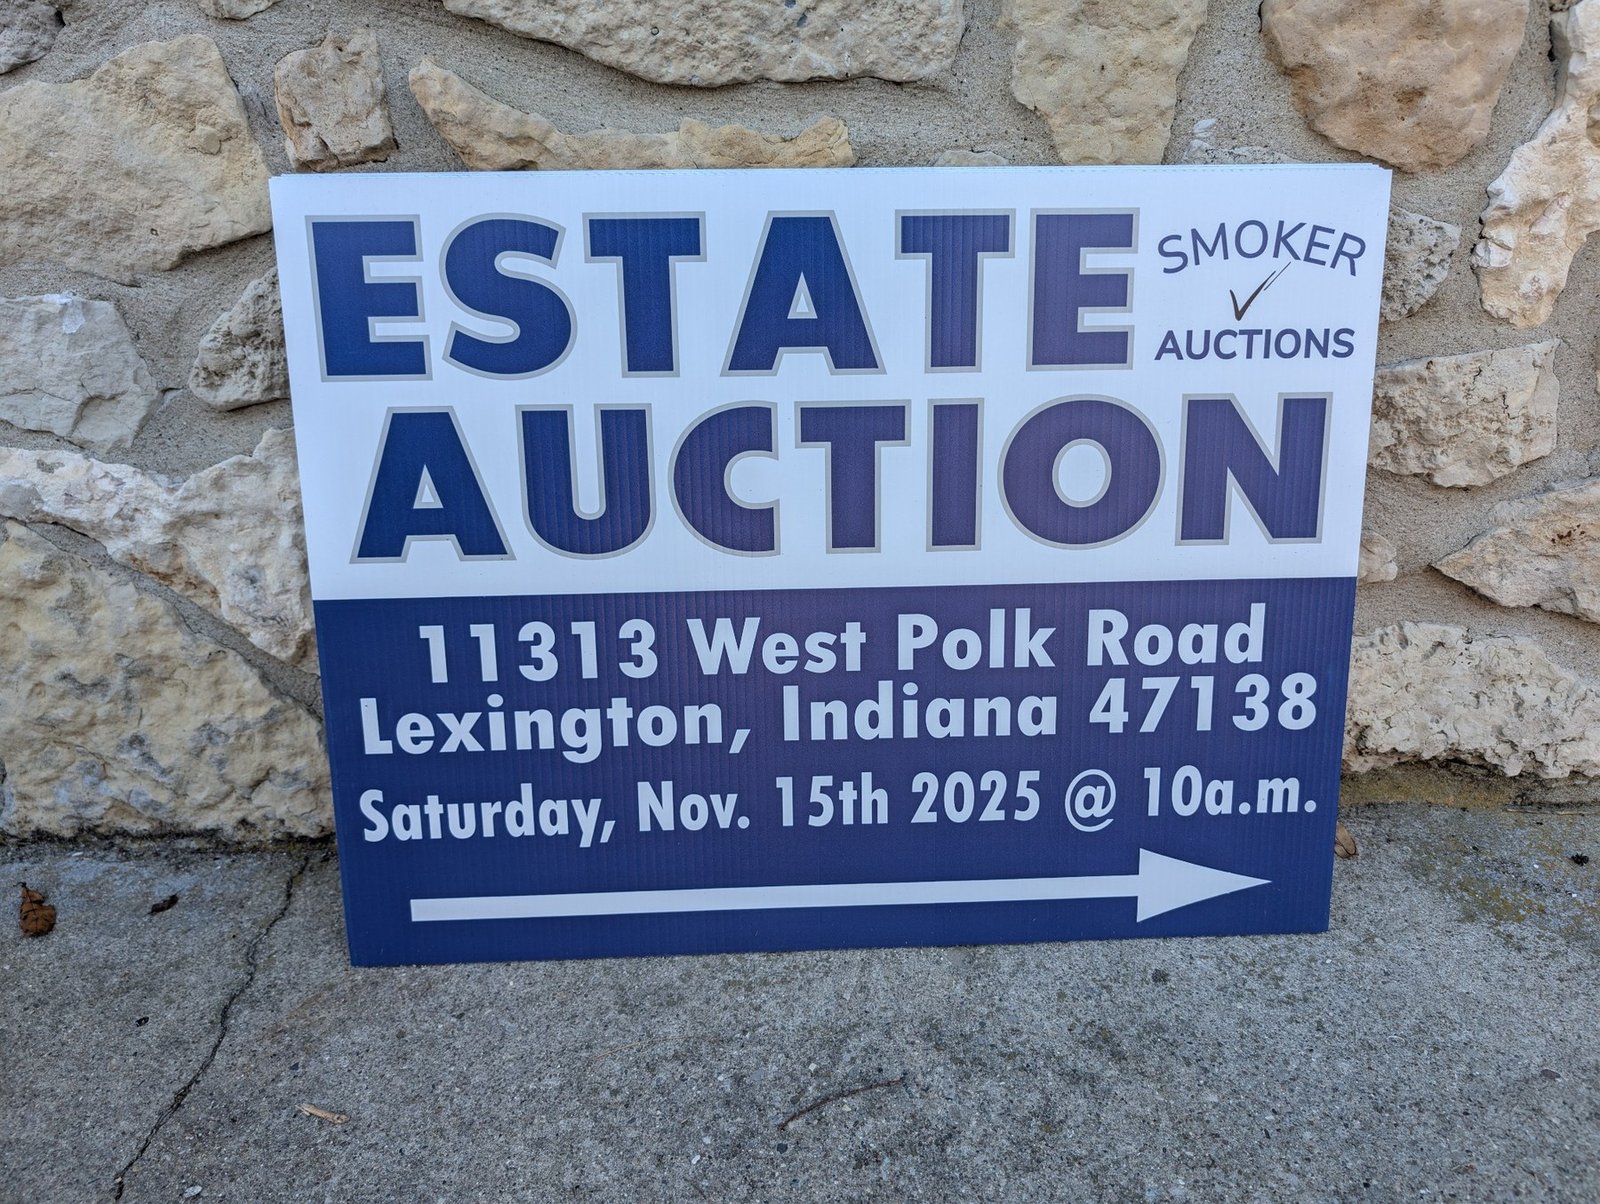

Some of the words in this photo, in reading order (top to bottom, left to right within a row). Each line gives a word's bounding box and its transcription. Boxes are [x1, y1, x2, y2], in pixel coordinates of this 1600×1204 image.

[1157, 219, 1366, 277] SMOKER
[305, 208, 1140, 383] ESTATE
[1154, 326, 1356, 361] AUCTIONS
[350, 392, 1334, 564] AUCTION
[419, 617, 658, 684] 11313
[686, 615, 867, 676] West
[897, 608, 1057, 672] Polk
[1086, 602, 1267, 667] Road
[359, 692, 751, 765] Lexington,
[782, 680, 1057, 742] Indiana
[1089, 672, 1318, 735] 47138
[359, 780, 617, 849] Saturday,
[637, 779, 751, 833] Nov.
[775, 772, 890, 827] 15th
[910, 770, 1042, 824] 2025
[1064, 768, 1118, 832] @
[1143, 764, 1319, 818] 10a.m.
